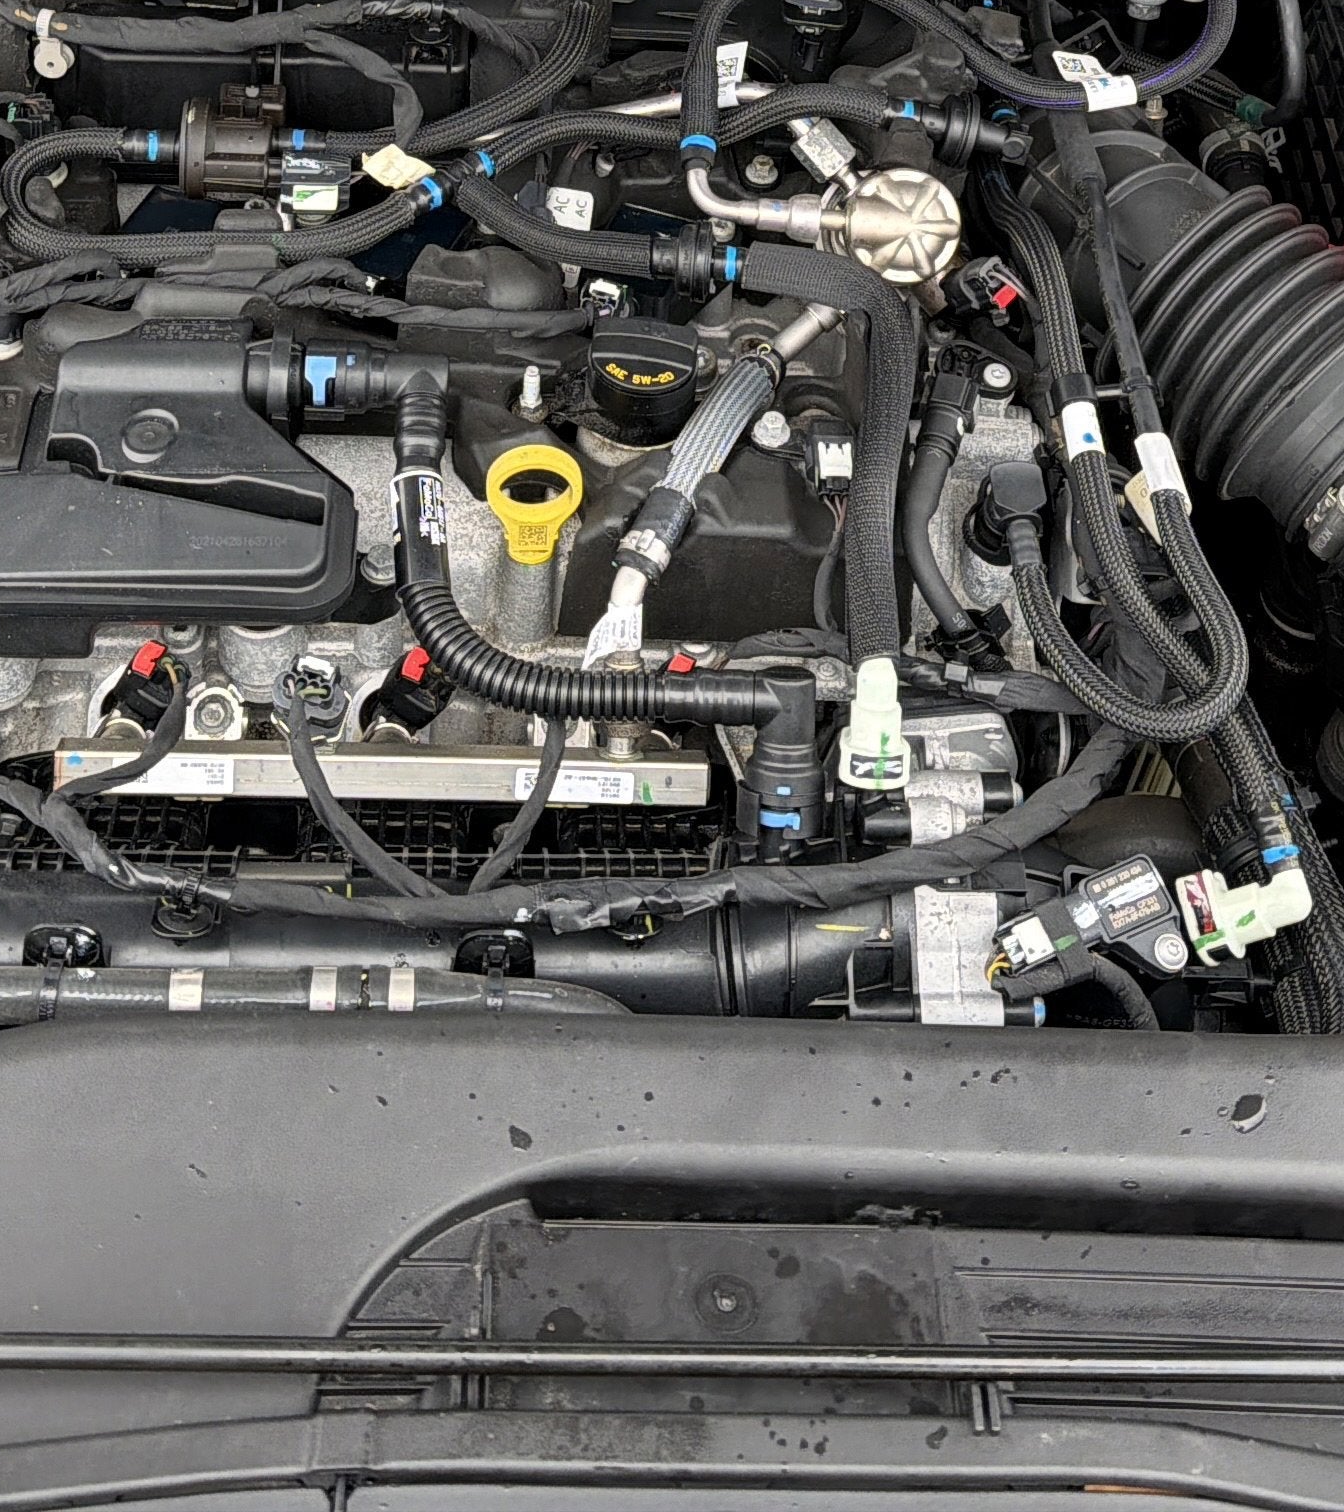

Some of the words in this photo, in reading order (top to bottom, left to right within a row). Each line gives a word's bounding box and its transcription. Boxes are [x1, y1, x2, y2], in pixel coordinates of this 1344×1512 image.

[553, 193, 570, 216] AC
[575, 196, 589, 218] AC
[605, 363, 628, 381] SAE
[632, 371, 675, 385] 5W-20
